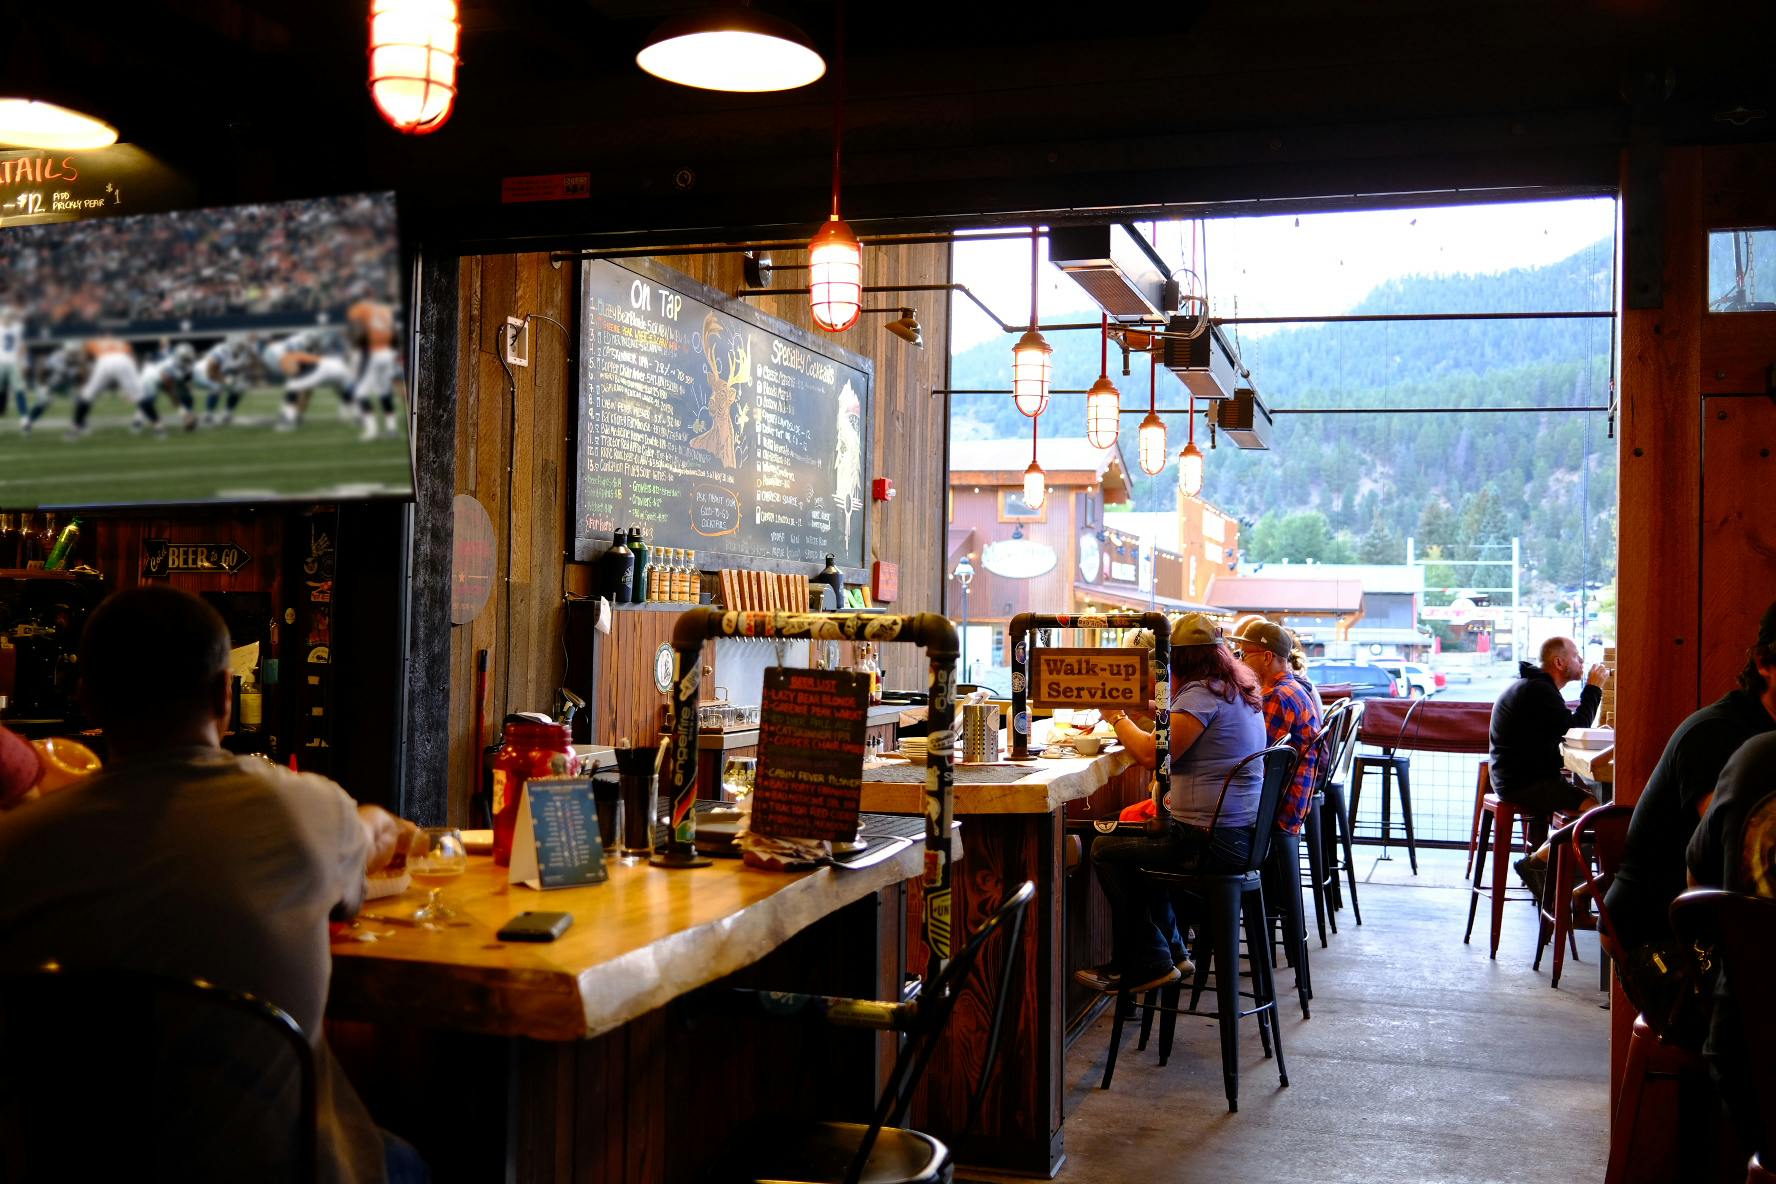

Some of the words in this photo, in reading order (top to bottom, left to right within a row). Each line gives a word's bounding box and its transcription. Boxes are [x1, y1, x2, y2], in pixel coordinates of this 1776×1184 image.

[168, 547, 207, 568] BEER
[222, 549, 238, 567] GO
[1044, 657, 1137, 681] Walk-up
[1047, 681, 1134, 700] Service
